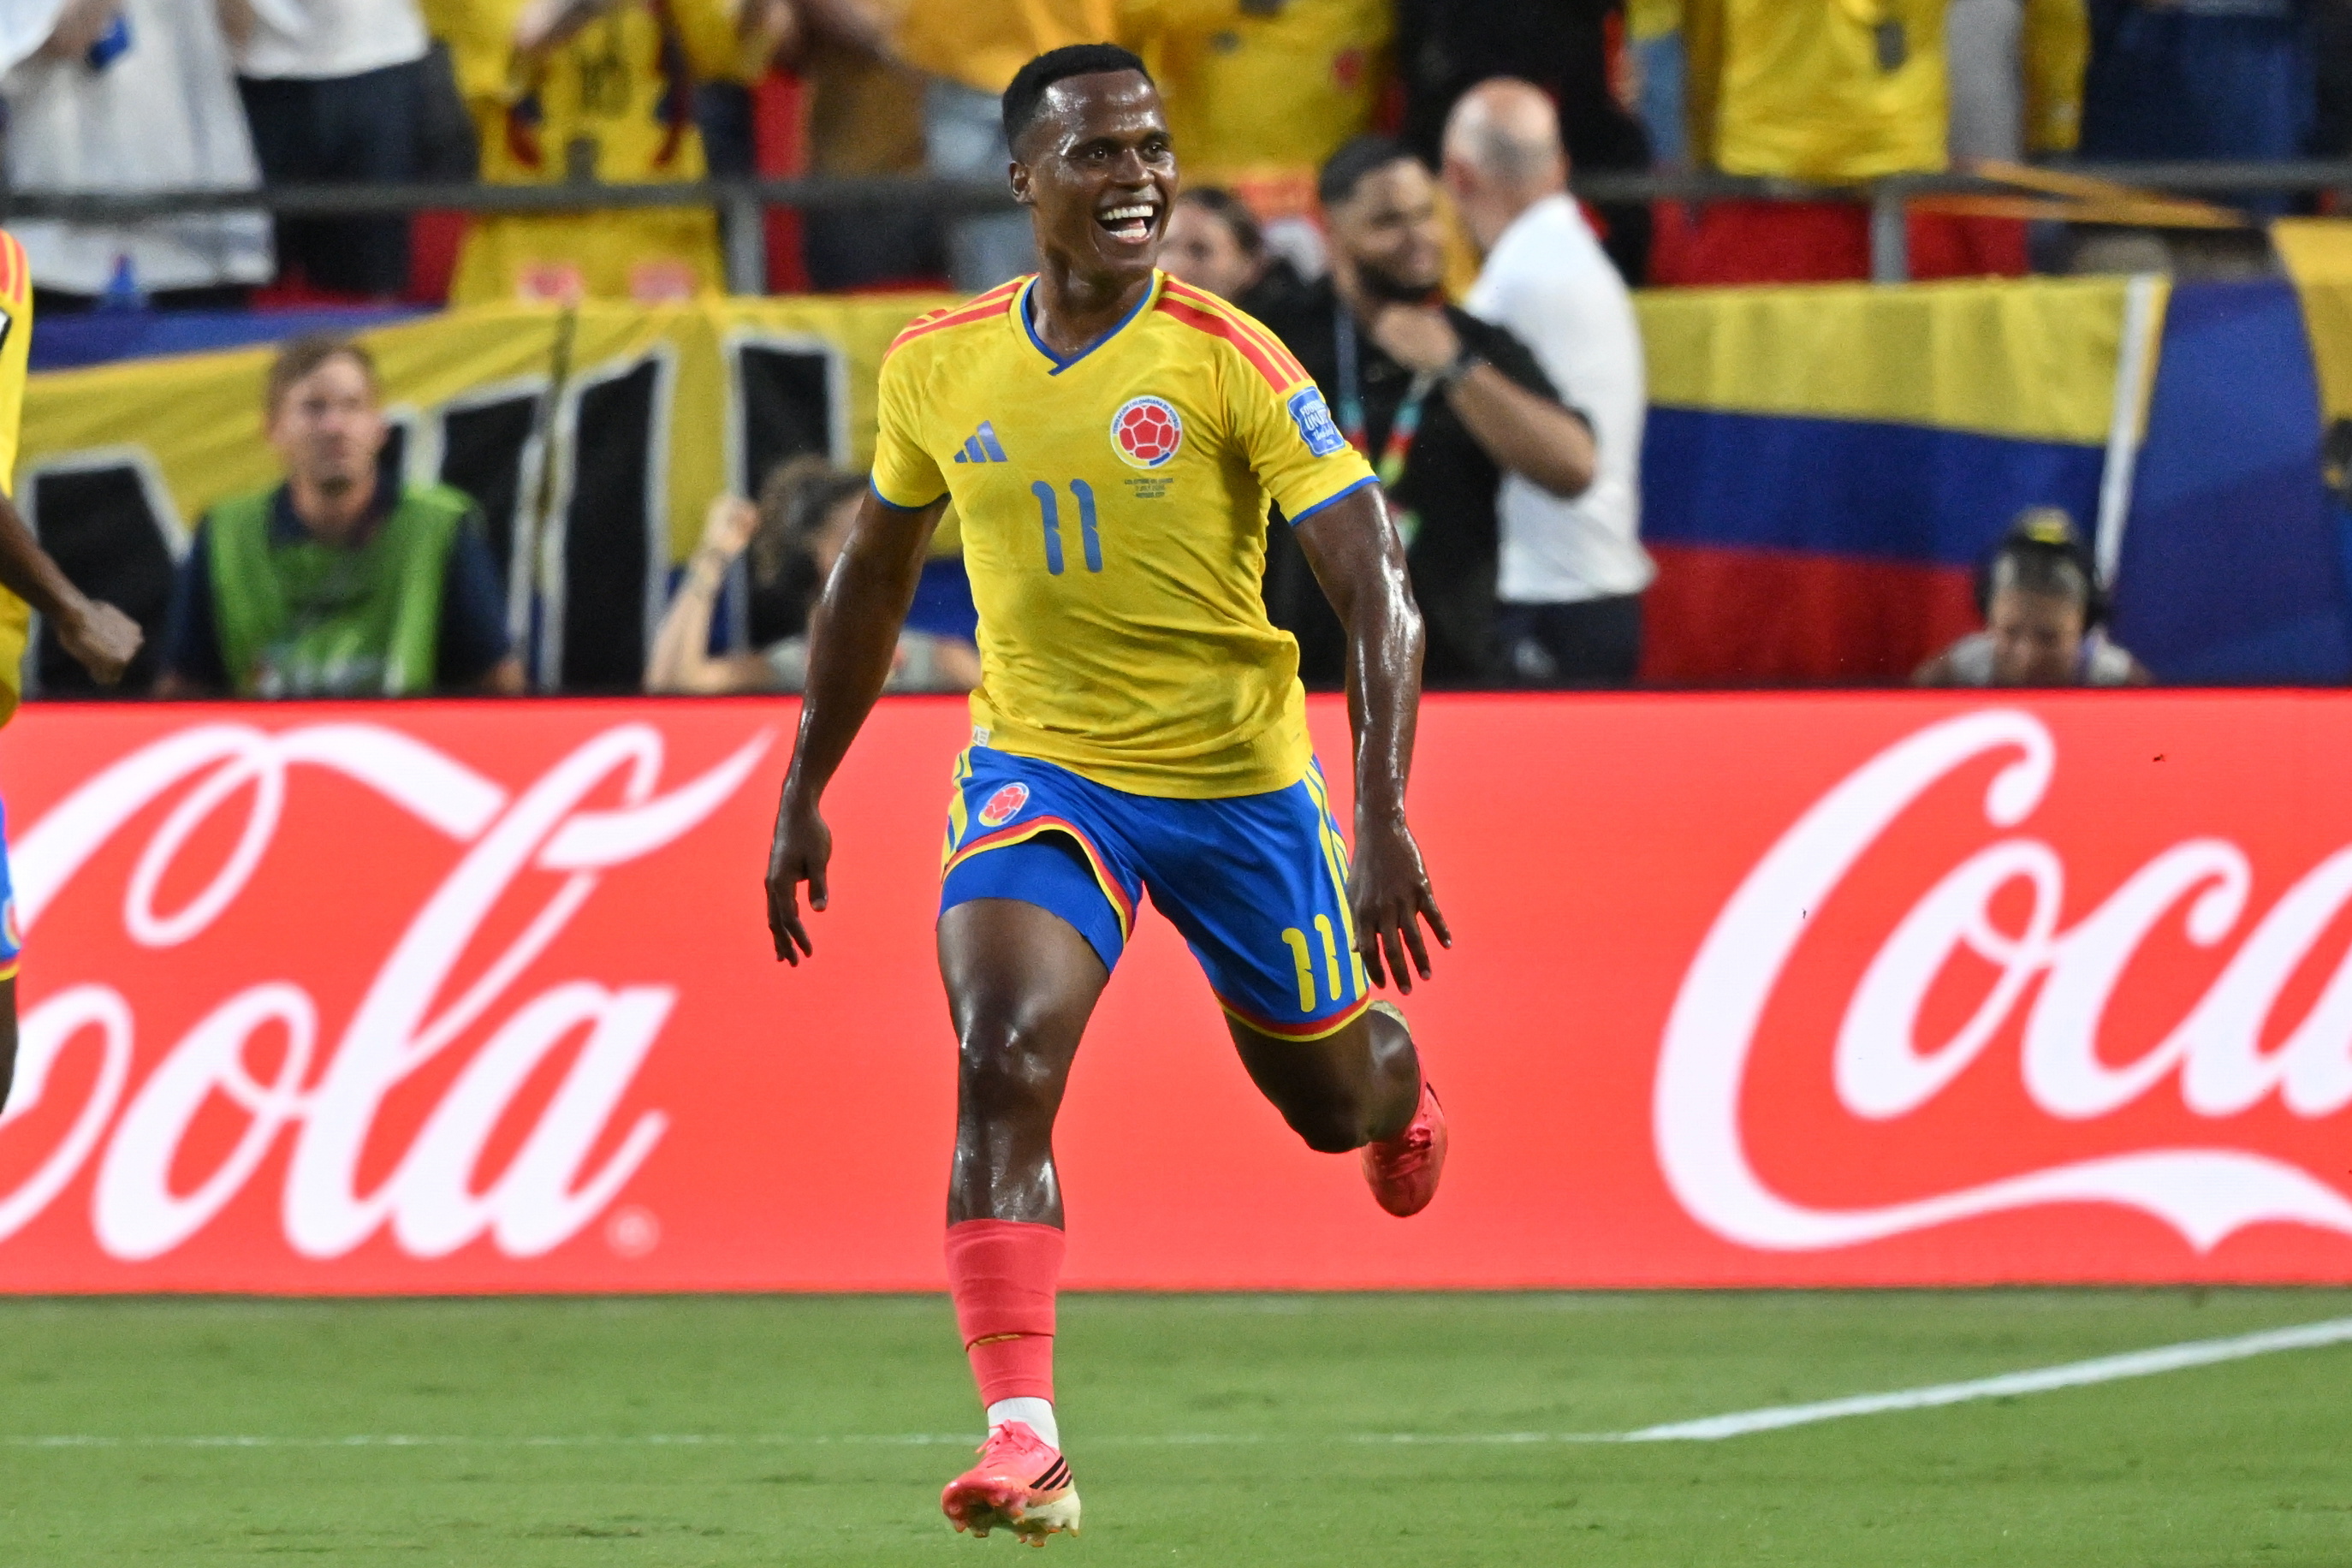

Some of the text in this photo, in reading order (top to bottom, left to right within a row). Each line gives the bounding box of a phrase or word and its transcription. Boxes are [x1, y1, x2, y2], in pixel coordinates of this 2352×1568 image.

[1030, 478, 1103, 575] 11
[1281, 913, 1343, 1013] 11
[1652, 708, 2352, 1256] Coca
